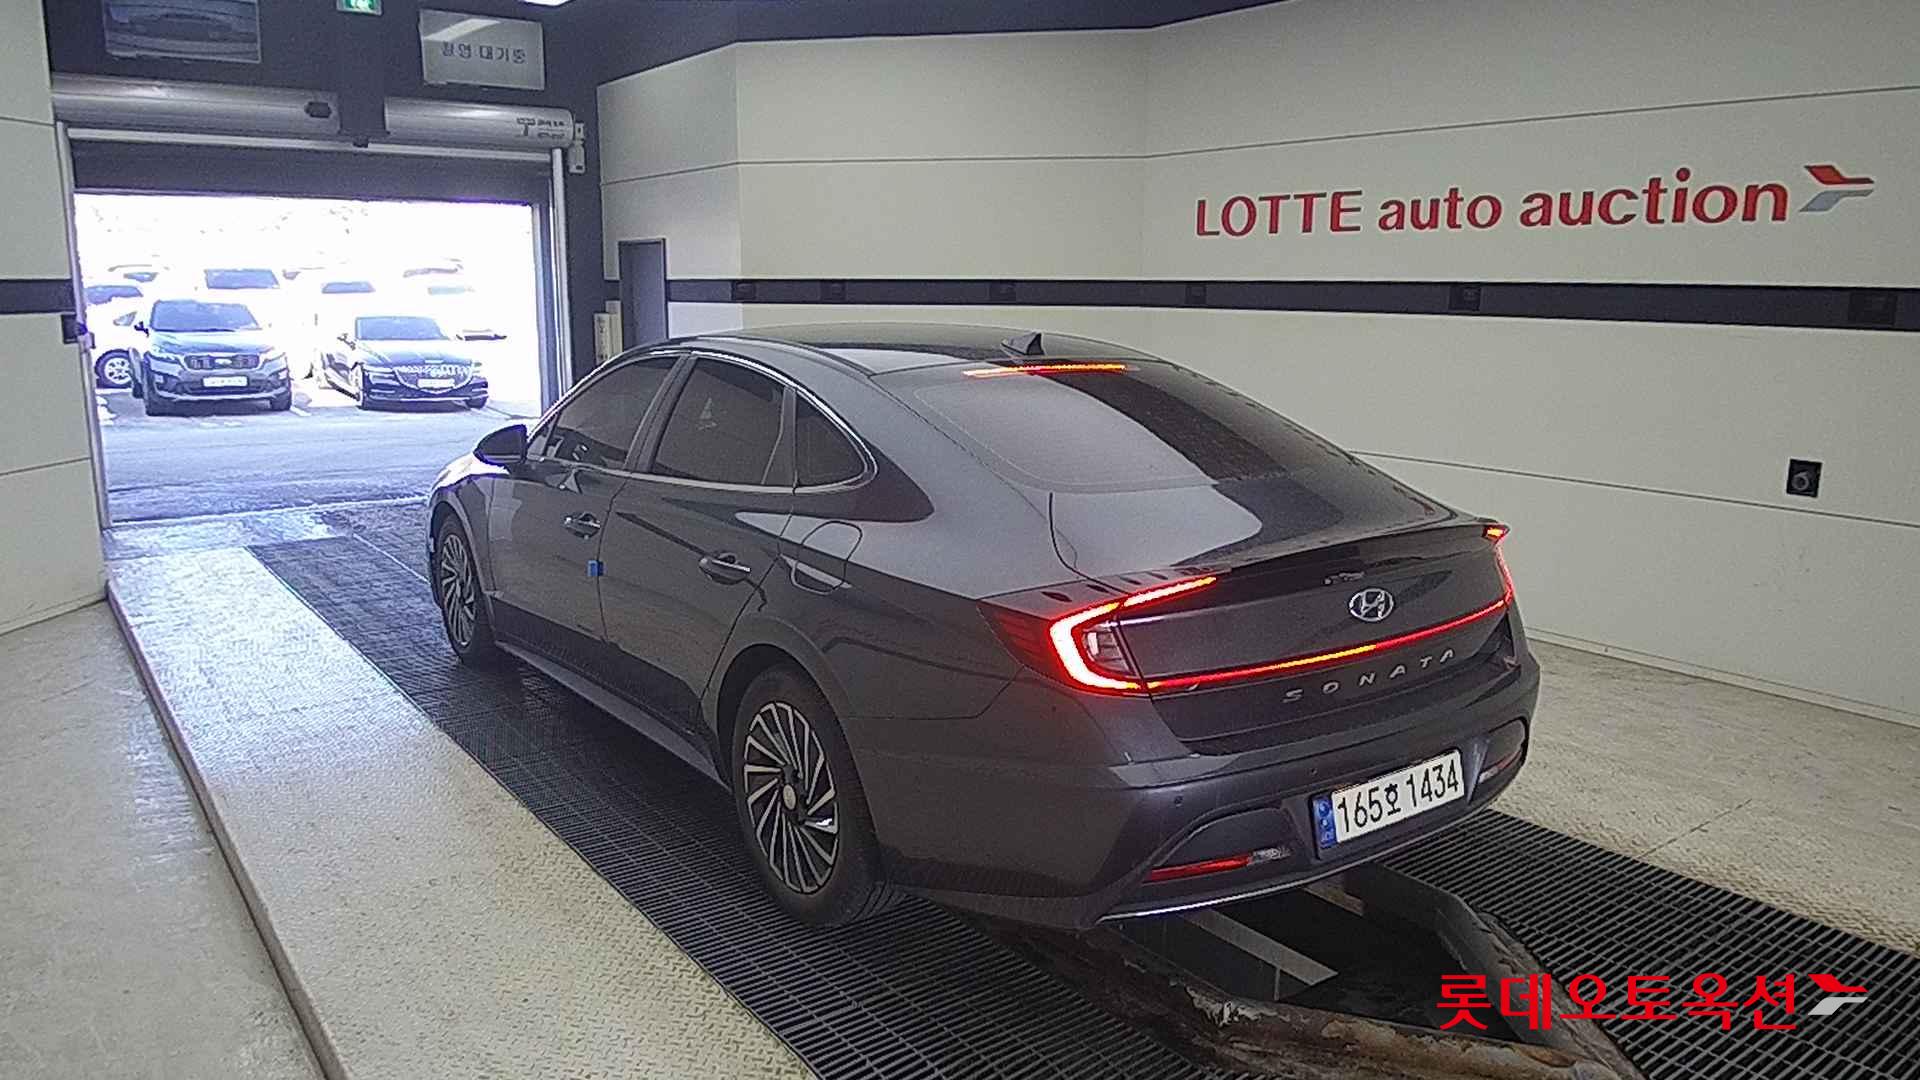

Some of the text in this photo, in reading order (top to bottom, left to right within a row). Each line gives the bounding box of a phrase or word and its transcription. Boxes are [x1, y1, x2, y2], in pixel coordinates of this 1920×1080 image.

[1195, 167, 1789, 238] LOTTE auto auction
[1282, 649, 1456, 703] SONATA
